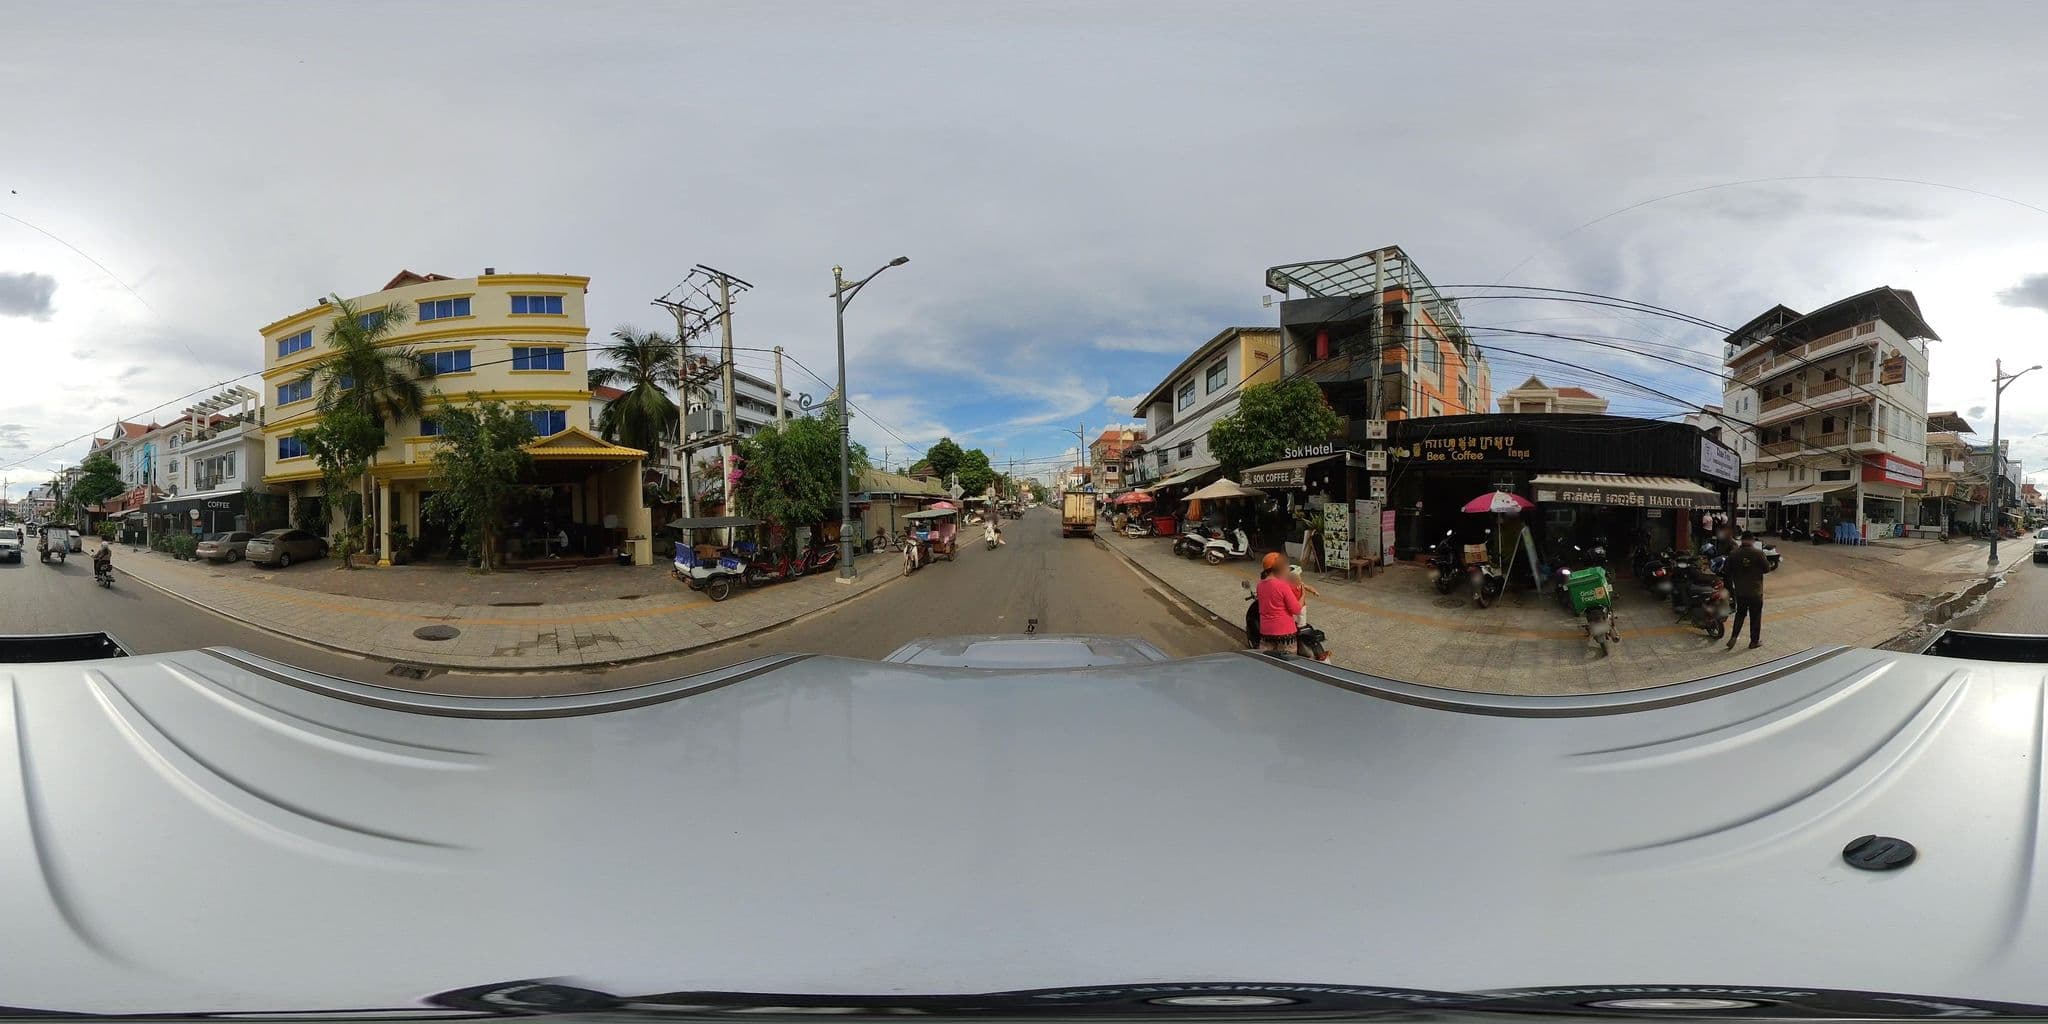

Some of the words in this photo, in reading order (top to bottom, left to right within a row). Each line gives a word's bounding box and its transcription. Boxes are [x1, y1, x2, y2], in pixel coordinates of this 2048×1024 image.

[1285, 447, 1303, 458] Sok
[1305, 442, 1333, 456] Hotel
[1427, 452, 1446, 461] Bee
[1451, 450, 1484, 461] Coffee
[1253, 474, 1264, 483] SOK
[1265, 472, 1288, 482] COFFEE
[207, 501, 230, 509] COFFEE
[1649, 495, 1673, 506] HAIR
[1675, 497, 1693, 507] CUT
